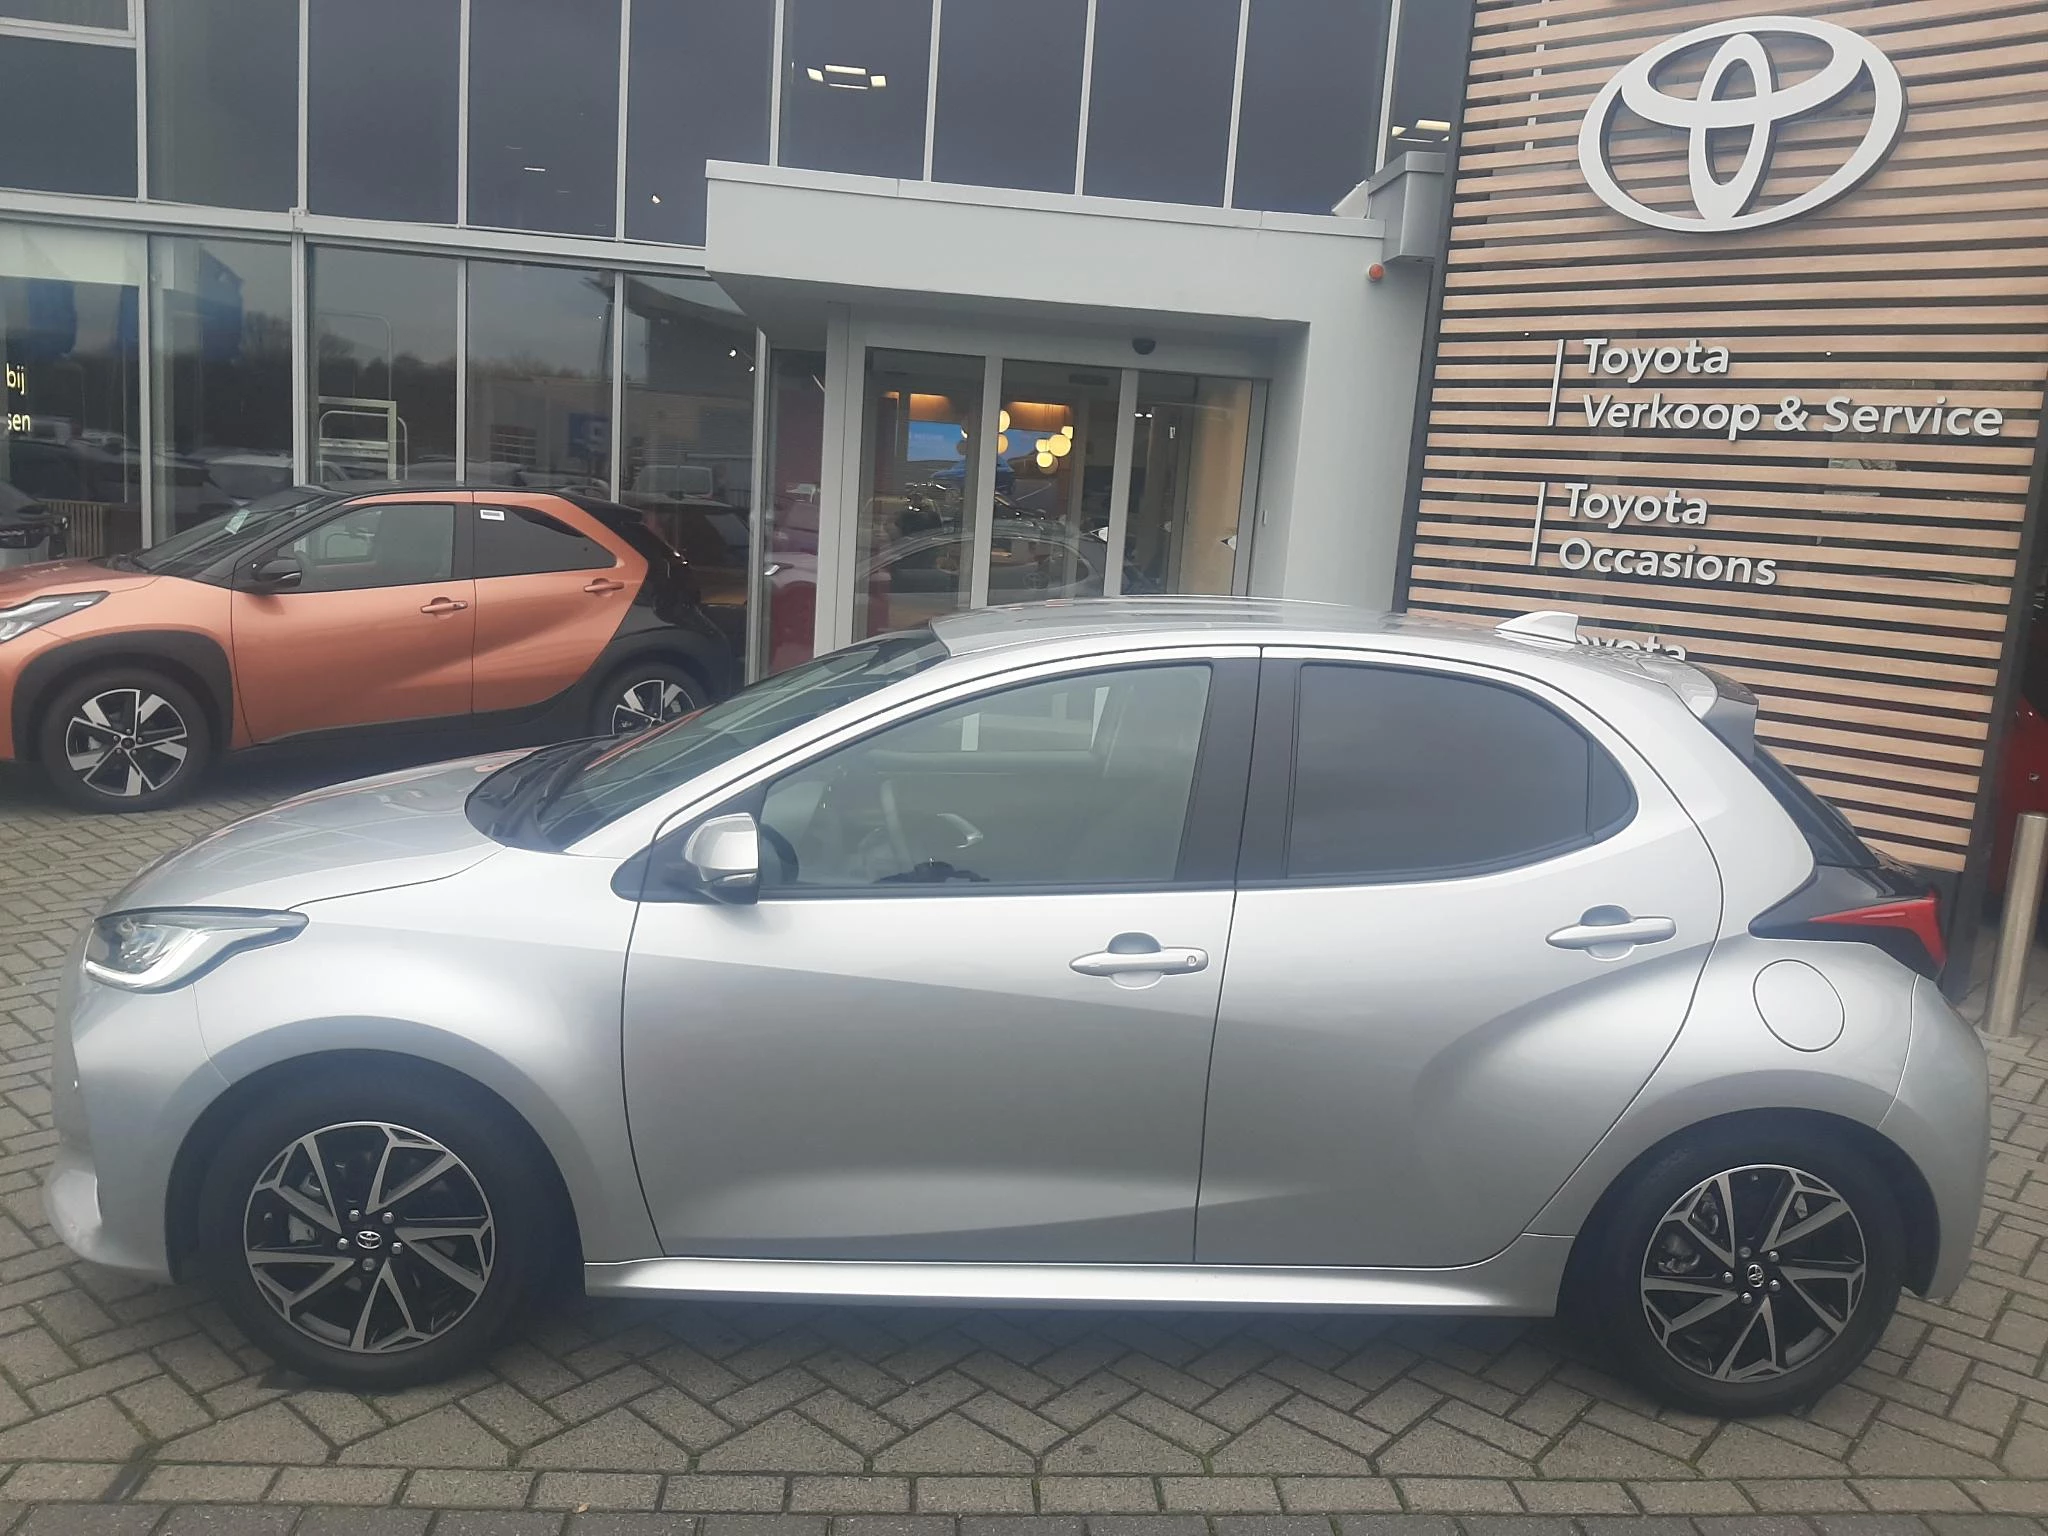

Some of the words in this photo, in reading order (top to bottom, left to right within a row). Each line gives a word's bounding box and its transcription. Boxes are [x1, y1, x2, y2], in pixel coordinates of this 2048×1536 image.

[6, 362, 25, 395] bij
[1583, 338, 1730, 384] Toyota
[1583, 392, 1760, 441] Verkoop
[1774, 395, 1809, 432] &
[1823, 395, 2003, 436] Service
[1564, 483, 1708, 529] Toyota
[1559, 537, 1778, 586] Occasions
